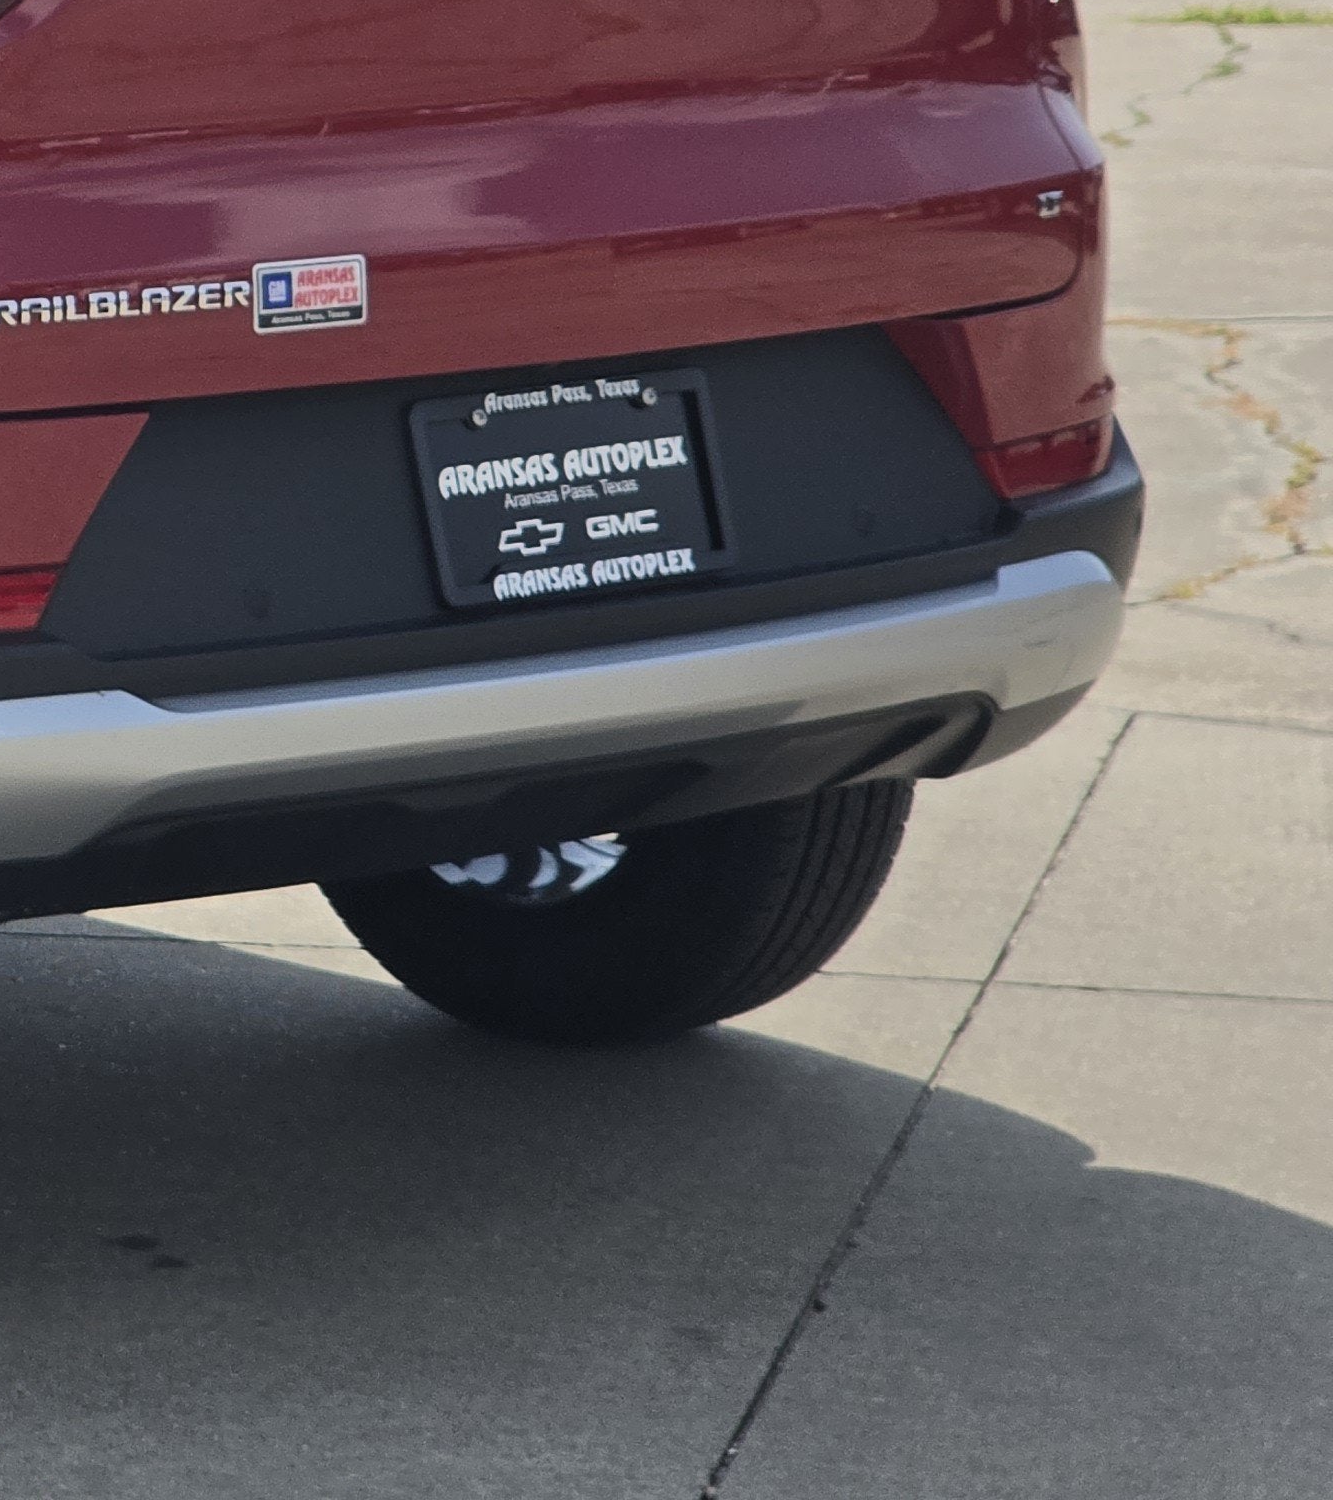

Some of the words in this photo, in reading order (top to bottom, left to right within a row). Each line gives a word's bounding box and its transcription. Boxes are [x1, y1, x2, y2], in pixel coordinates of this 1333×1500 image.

[297, 266, 355, 286] ARANSAS
[294, 285, 358, 308] AUTOPLEX
[484, 390, 549, 414] Aransas
[595, 378, 641, 399] Texas
[438, 452, 559, 500] ARANSAS
[563, 435, 688, 481] AUTOPLEX
[504, 490, 559, 510] Aransas
[599, 479, 639, 496] Texas
[586, 509, 659, 539] GMC
[493, 563, 588, 601] ARANSAS
[592, 548, 696, 586] AUTOPLEX
